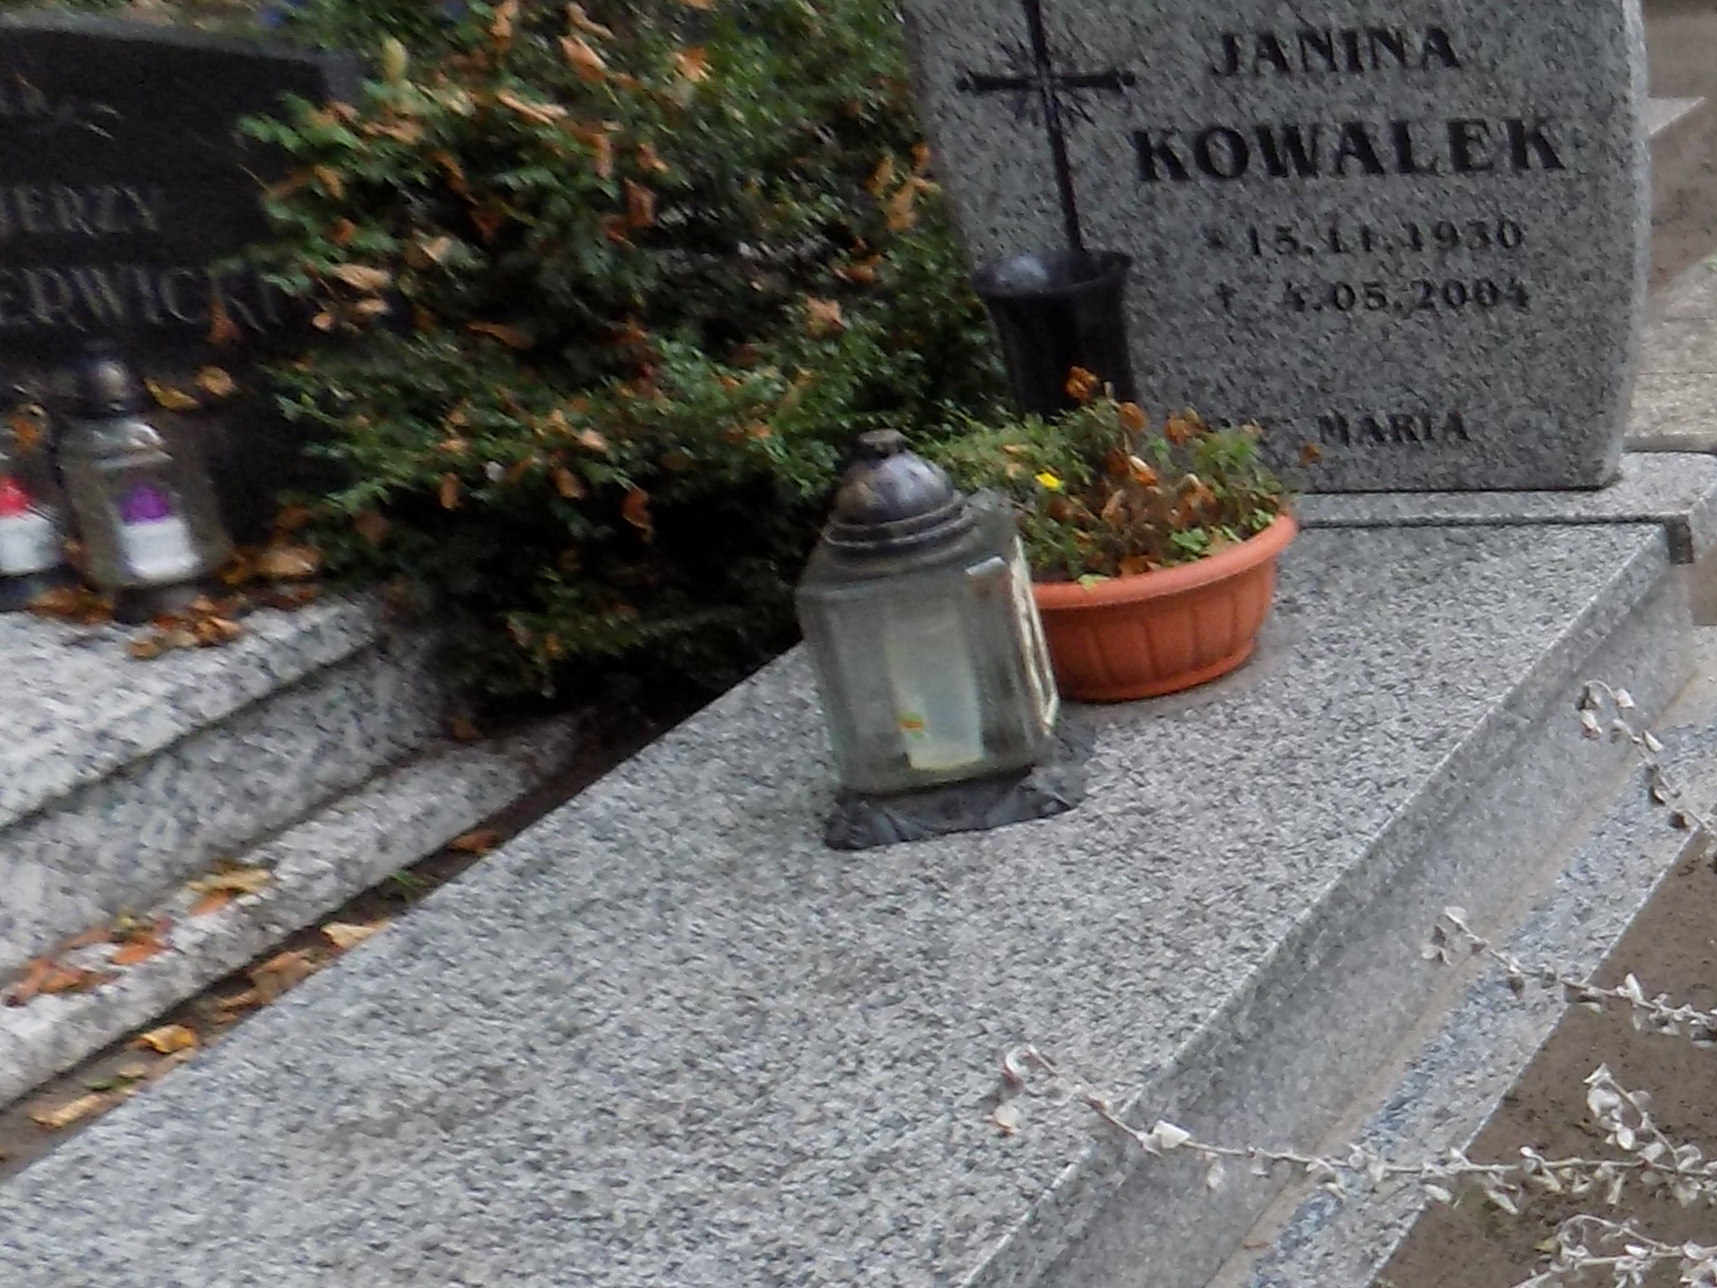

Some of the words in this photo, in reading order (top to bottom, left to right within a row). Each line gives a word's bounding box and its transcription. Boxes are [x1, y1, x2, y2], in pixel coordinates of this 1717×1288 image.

[1210, 25, 1463, 79] JANINA
[1131, 116, 1569, 183] KOWALEK
[1317, 412, 1474, 448] MARIA
